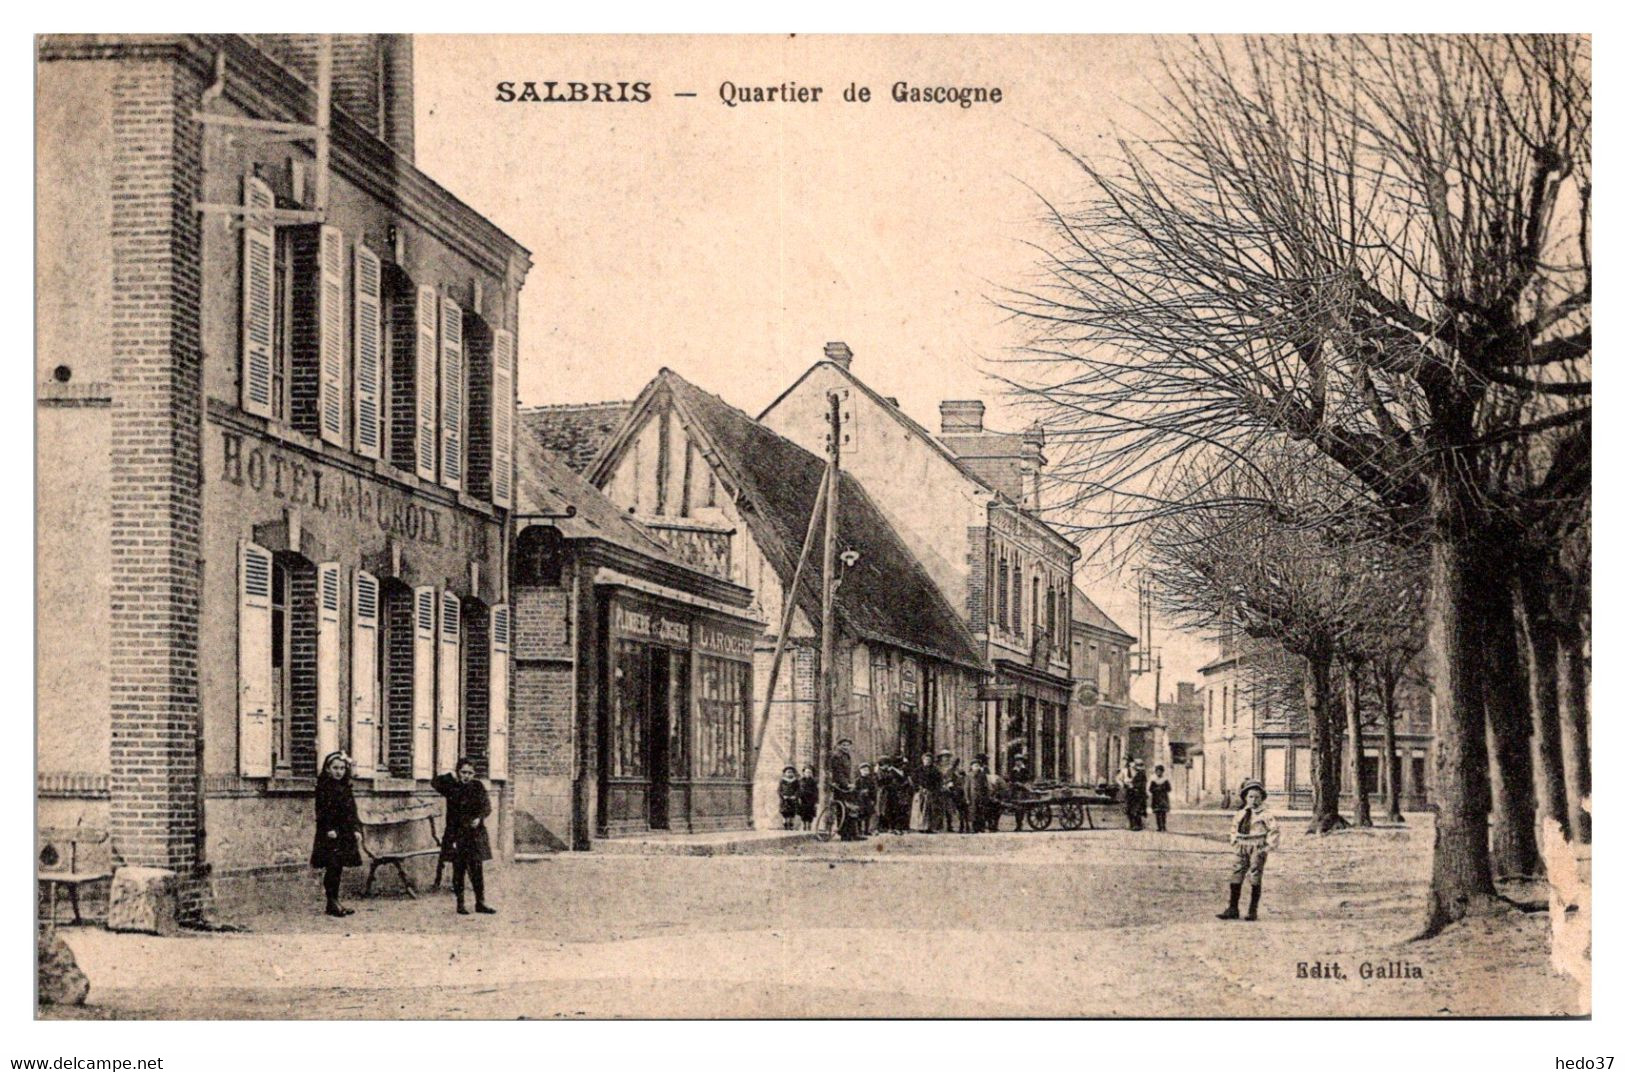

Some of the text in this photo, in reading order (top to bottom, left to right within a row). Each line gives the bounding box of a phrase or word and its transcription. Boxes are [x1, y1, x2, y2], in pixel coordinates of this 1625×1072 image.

[222, 431, 328, 514] HOTEL
[376, 487, 444, 546] CROIX
[699, 624, 751, 656] LAROCHE
